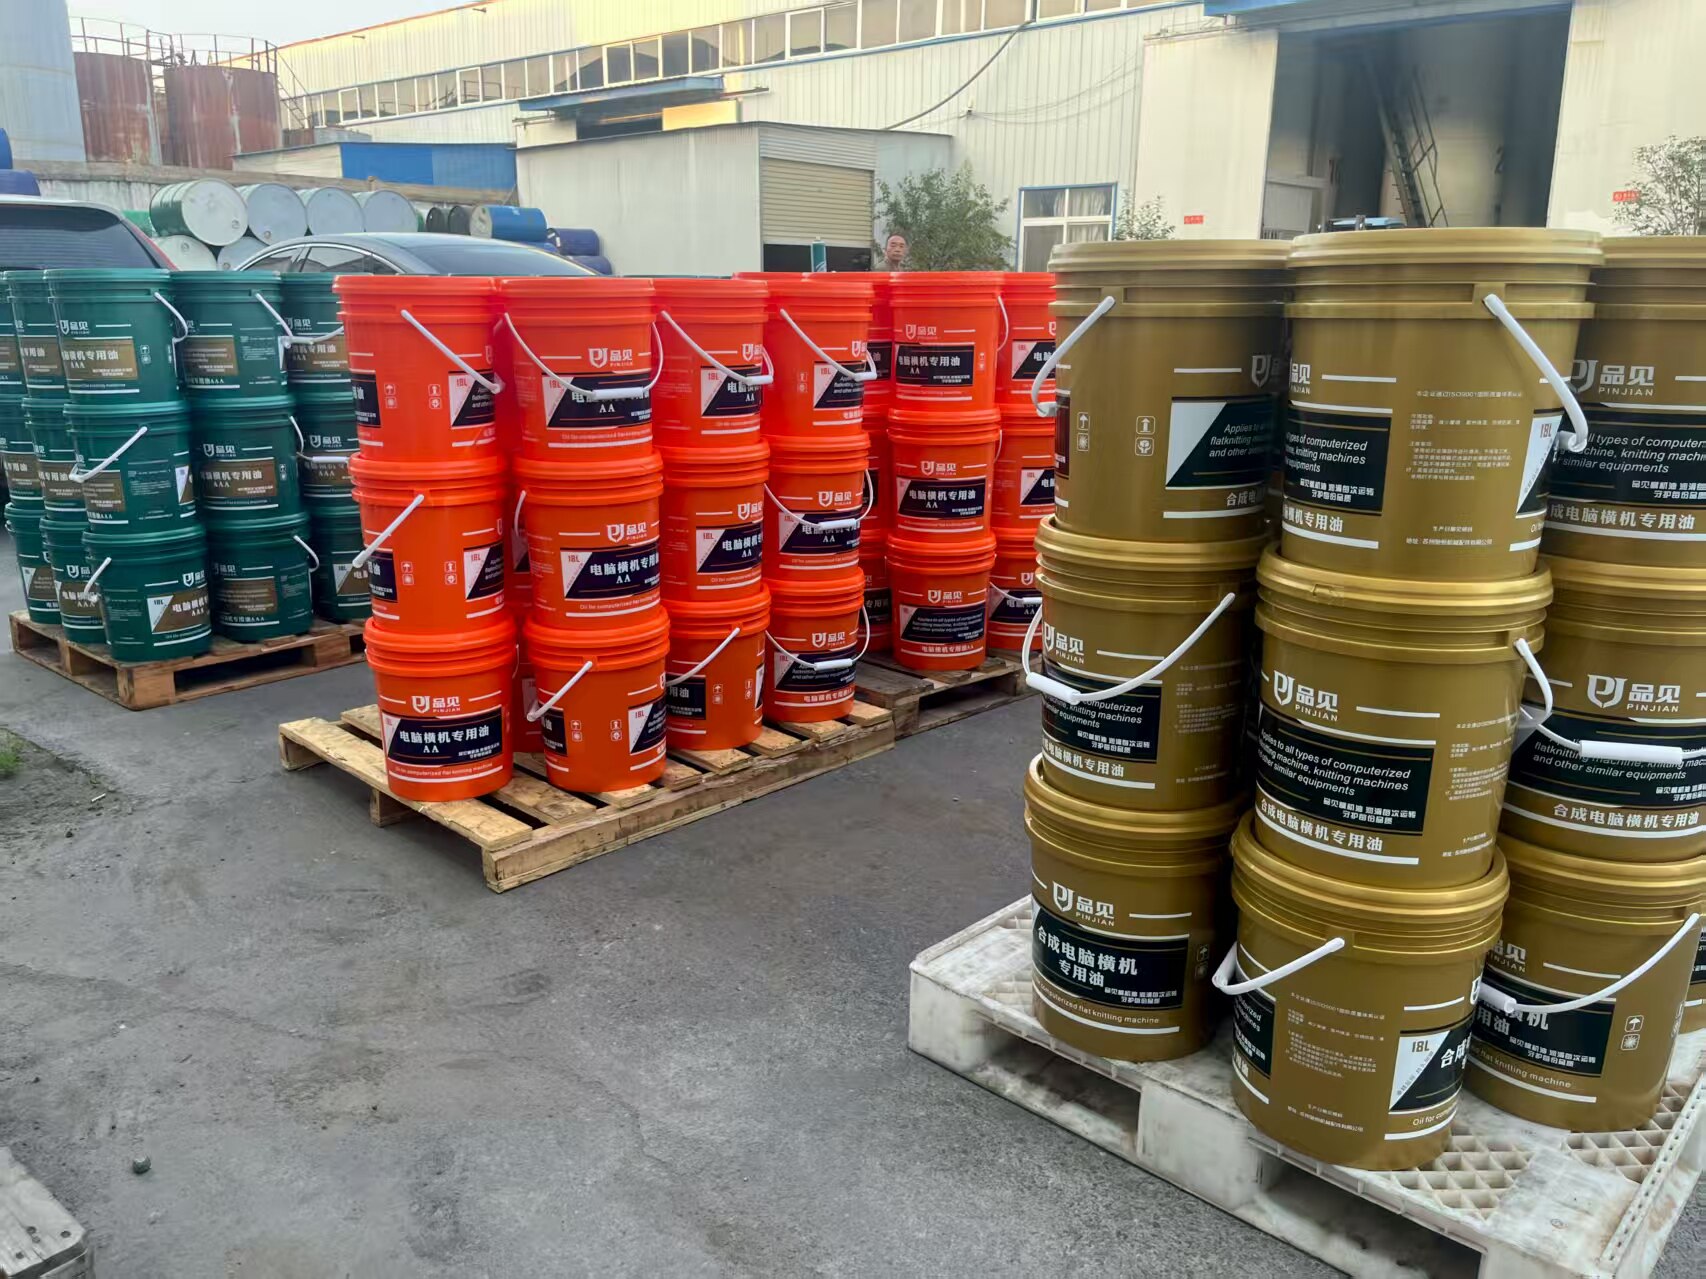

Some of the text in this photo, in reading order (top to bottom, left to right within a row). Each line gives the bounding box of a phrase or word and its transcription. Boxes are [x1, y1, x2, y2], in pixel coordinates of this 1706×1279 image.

[918, 326, 937, 336] 品见
[610, 349, 632, 361] 品见
[1599, 365, 1655, 386] 品见
[1598, 387, 1654, 397] PINJIAN
[1306, 437, 1368, 451] computerized
[1597, 434, 1629, 446] types
[1631, 436, 1645, 446] of
[1209, 448, 1227, 457] and
[1319, 452, 1367, 465] machines
[1621, 448, 1666, 462] knitting
[935, 462, 957, 472] 品见
[1599, 461, 1670, 474] equipments
[834, 491, 852, 502] 品见
[909, 490, 976, 501] 电脑横机专用油
[626, 522, 647, 536] 品见
[567, 555, 580, 563] 18L
[616, 575, 631, 584] AA
[943, 591, 963, 600] 品见
[827, 631, 846, 642] 品见
[1056, 632, 1084, 656] 品见
[1295, 684, 1338, 713] 品见
[1628, 683, 1681, 704] 品见
[433, 696, 460, 708] 品见
[1627, 703, 1679, 713] PINJIAN
[635, 710, 645, 718] 18L
[1059, 710, 1101, 729] equipments
[1097, 711, 1143, 724] machines
[1295, 704, 1338, 722] PINJIAN
[400, 725, 490, 744] 电脑横机专用油
[423, 745, 439, 753] AA
[1284, 743, 1295, 754] all
[1295, 748, 1320, 763] types
[1321, 757, 1333, 766] of
[1333, 760, 1411, 779] computerized
[1533, 754, 1687, 781] and other similar equipments
[1273, 762, 1356, 796] similar equipments
[1276, 754, 1409, 791] machine, knitting machines
[1554, 804, 1700, 829] 合成电脑横机专用油
[1260, 798, 1384, 852] 合成电脑横机专用油
[1076, 895, 1115, 920] 品见
[1075, 911, 1115, 927] PINJIAN
[1037, 925, 1138, 976] 合成电脑横机
[1058, 959, 1105, 988] 专用油
[1092, 1009, 1123, 1024] knitting
[1124, 1016, 1159, 1025] machine
[1411, 1040, 1430, 1053] 18L
[1494, 1057, 1528, 1078] knitting
[1529, 1072, 1572, 1088] machine
[1412, 1116, 1424, 1126] Oil
